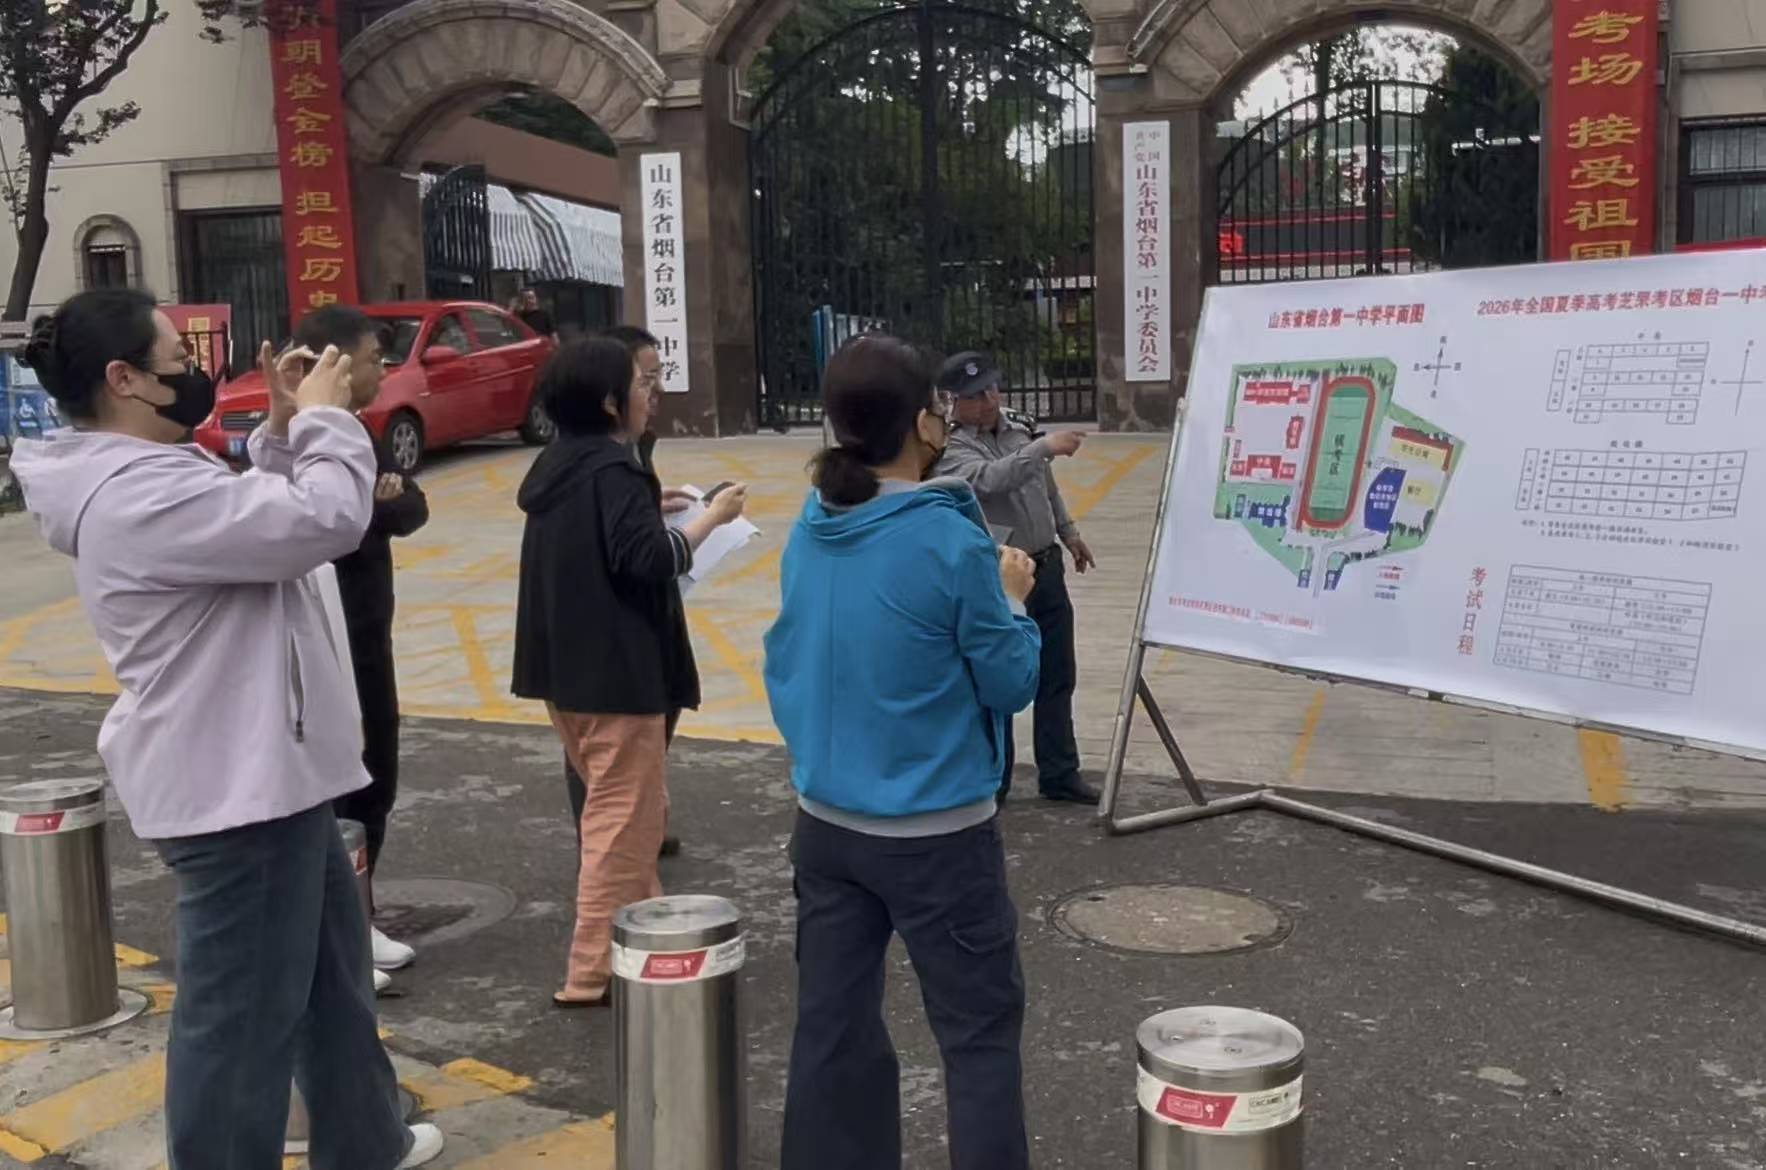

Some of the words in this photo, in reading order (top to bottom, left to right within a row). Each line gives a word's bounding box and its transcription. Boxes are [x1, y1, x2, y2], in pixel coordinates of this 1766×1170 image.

[1567, 10, 1644, 86] 考场
[1564, 113, 1640, 261] 接受祖国
[650, 164, 680, 382] 山东省烟台第一中学
[1136, 164, 1159, 373] 山东省烟台第一中学委员会
[1267, 303, 1425, 329] 山东省烟台第一中学平面图
[1457, 567, 1487, 656] 考试日程
